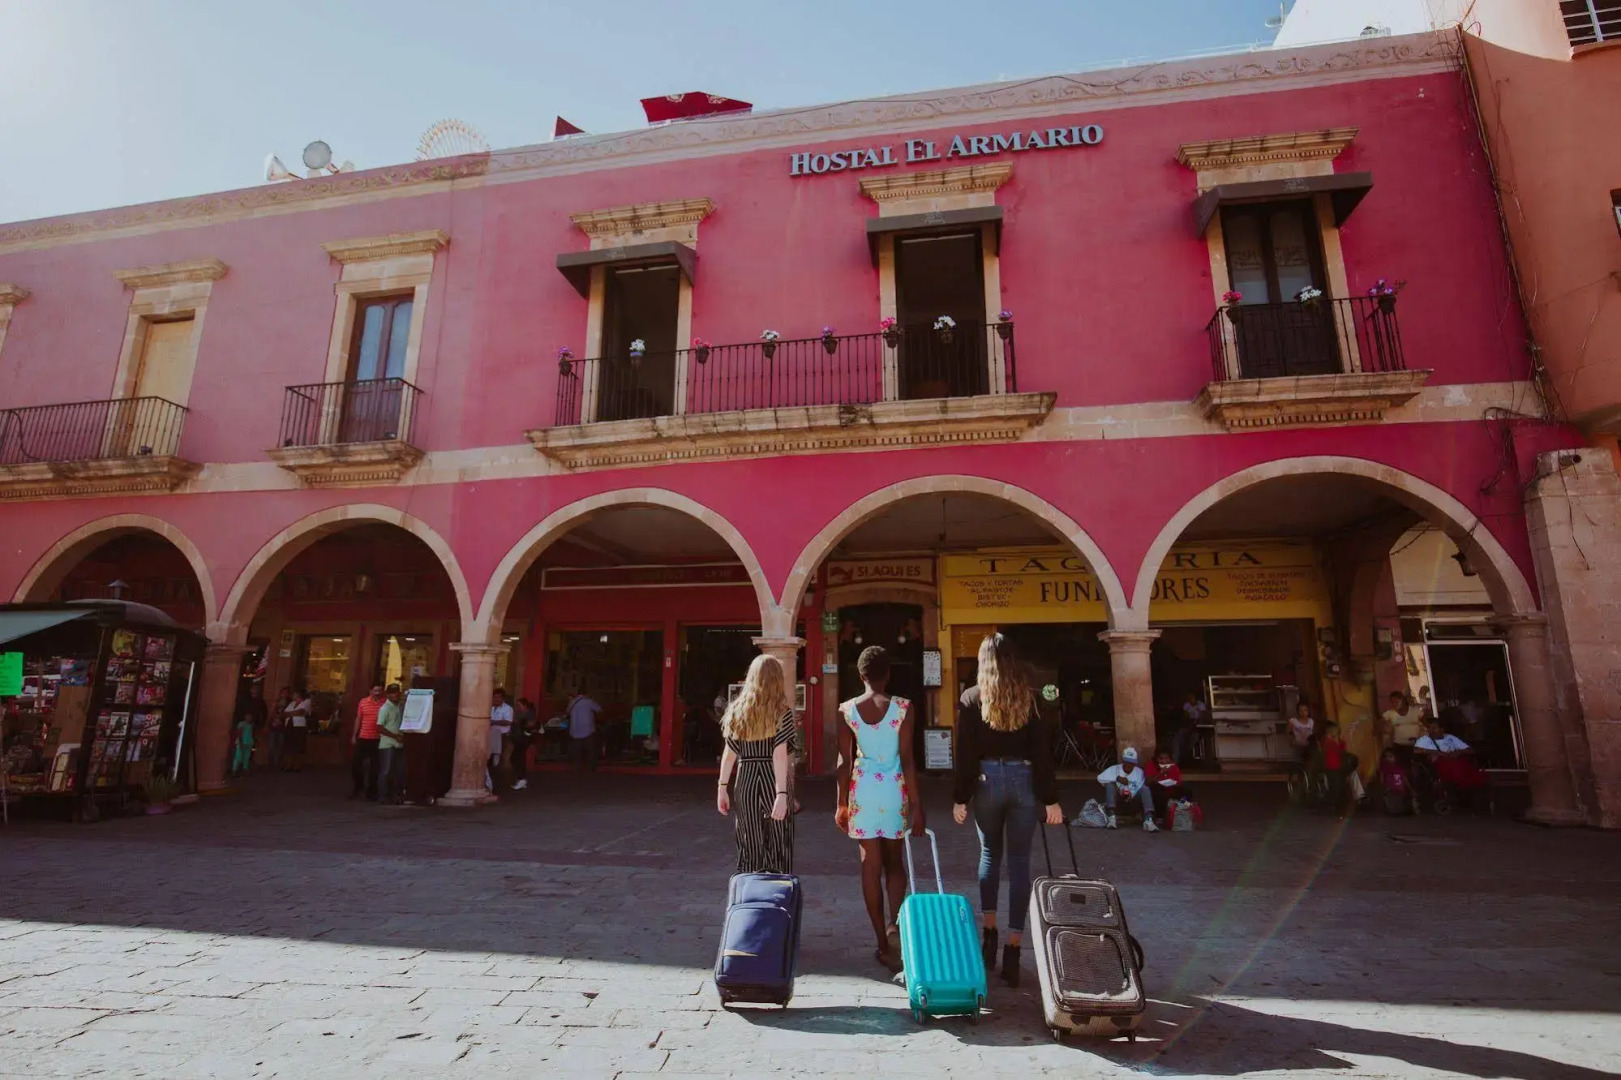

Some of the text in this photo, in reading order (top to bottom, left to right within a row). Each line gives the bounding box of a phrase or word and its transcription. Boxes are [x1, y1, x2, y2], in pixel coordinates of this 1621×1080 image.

[789, 124, 1104, 175] HOSTAL EL ARMARIO
